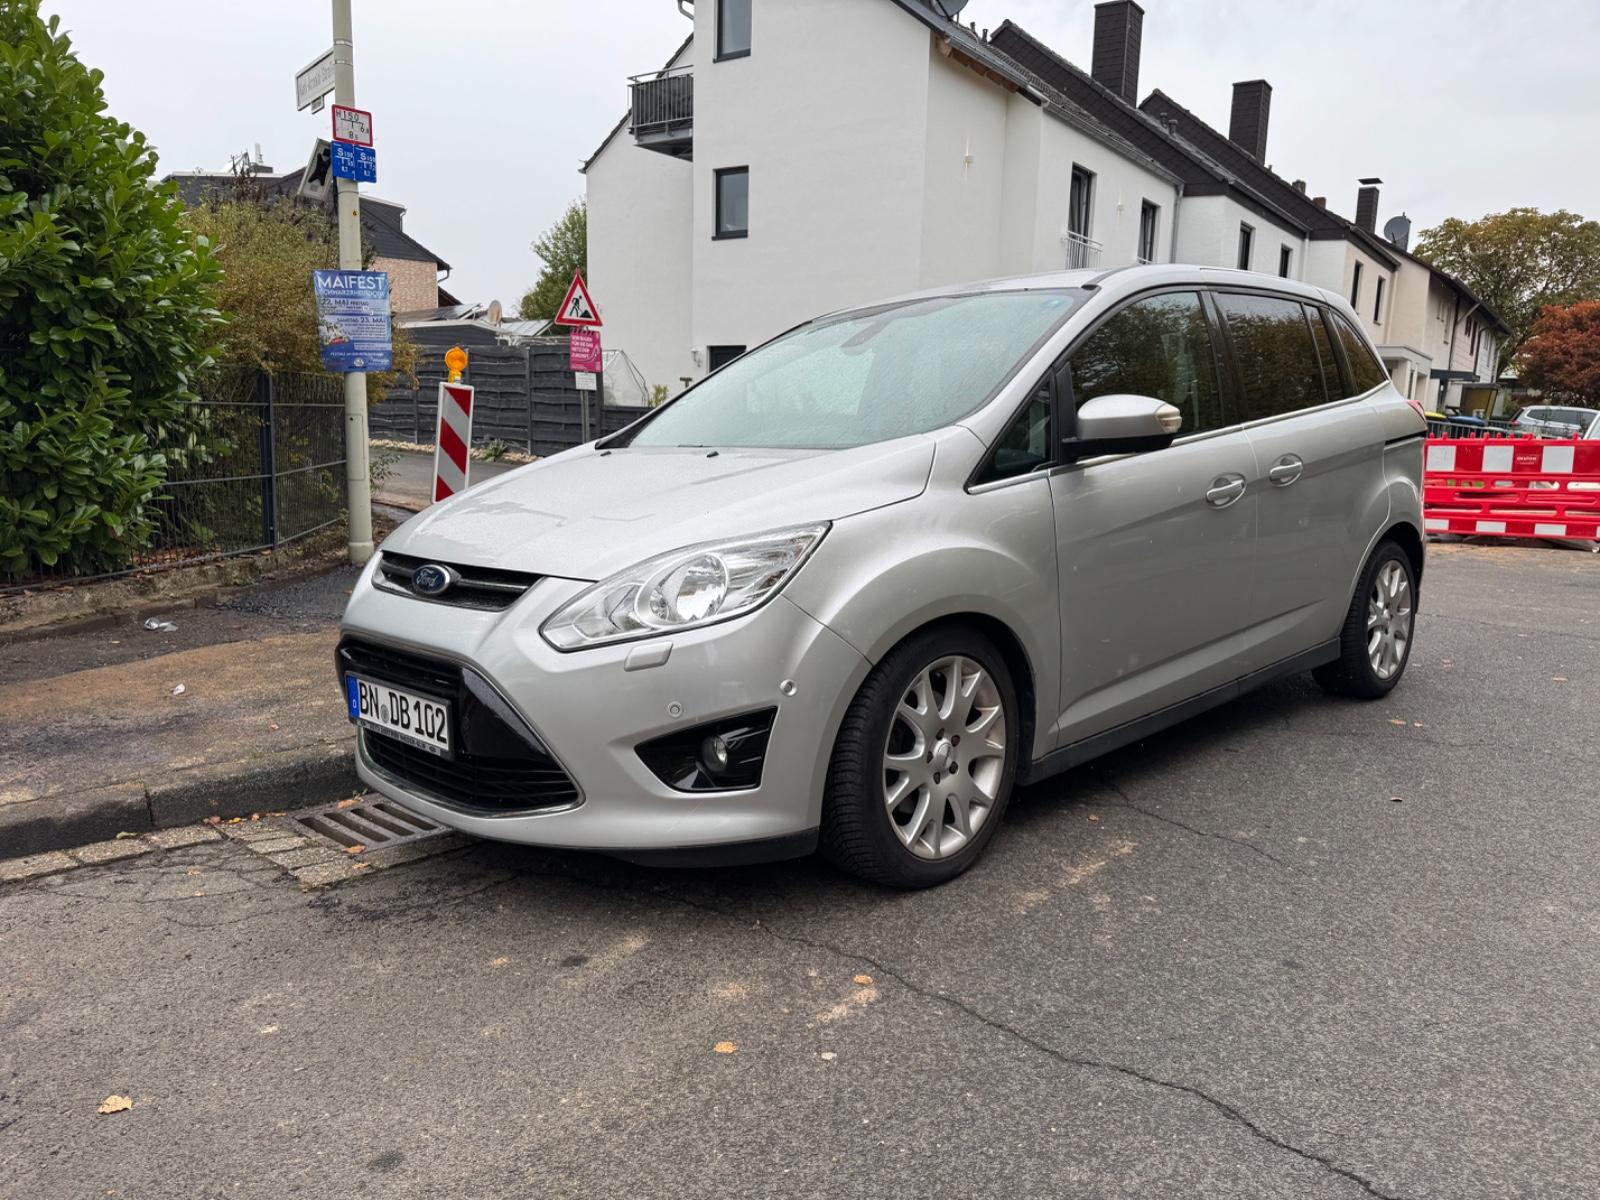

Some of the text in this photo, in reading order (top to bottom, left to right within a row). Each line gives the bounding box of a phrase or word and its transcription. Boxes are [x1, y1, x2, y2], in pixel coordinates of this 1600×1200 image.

[317, 274, 386, 290] MAIFEST
[334, 298, 348, 306] MAI
[417, 568, 438, 587] Ford
[352, 698, 358, 709] D
[359, 681, 380, 720] BN
[388, 691, 411, 730] DB
[413, 700, 447, 744] 102
